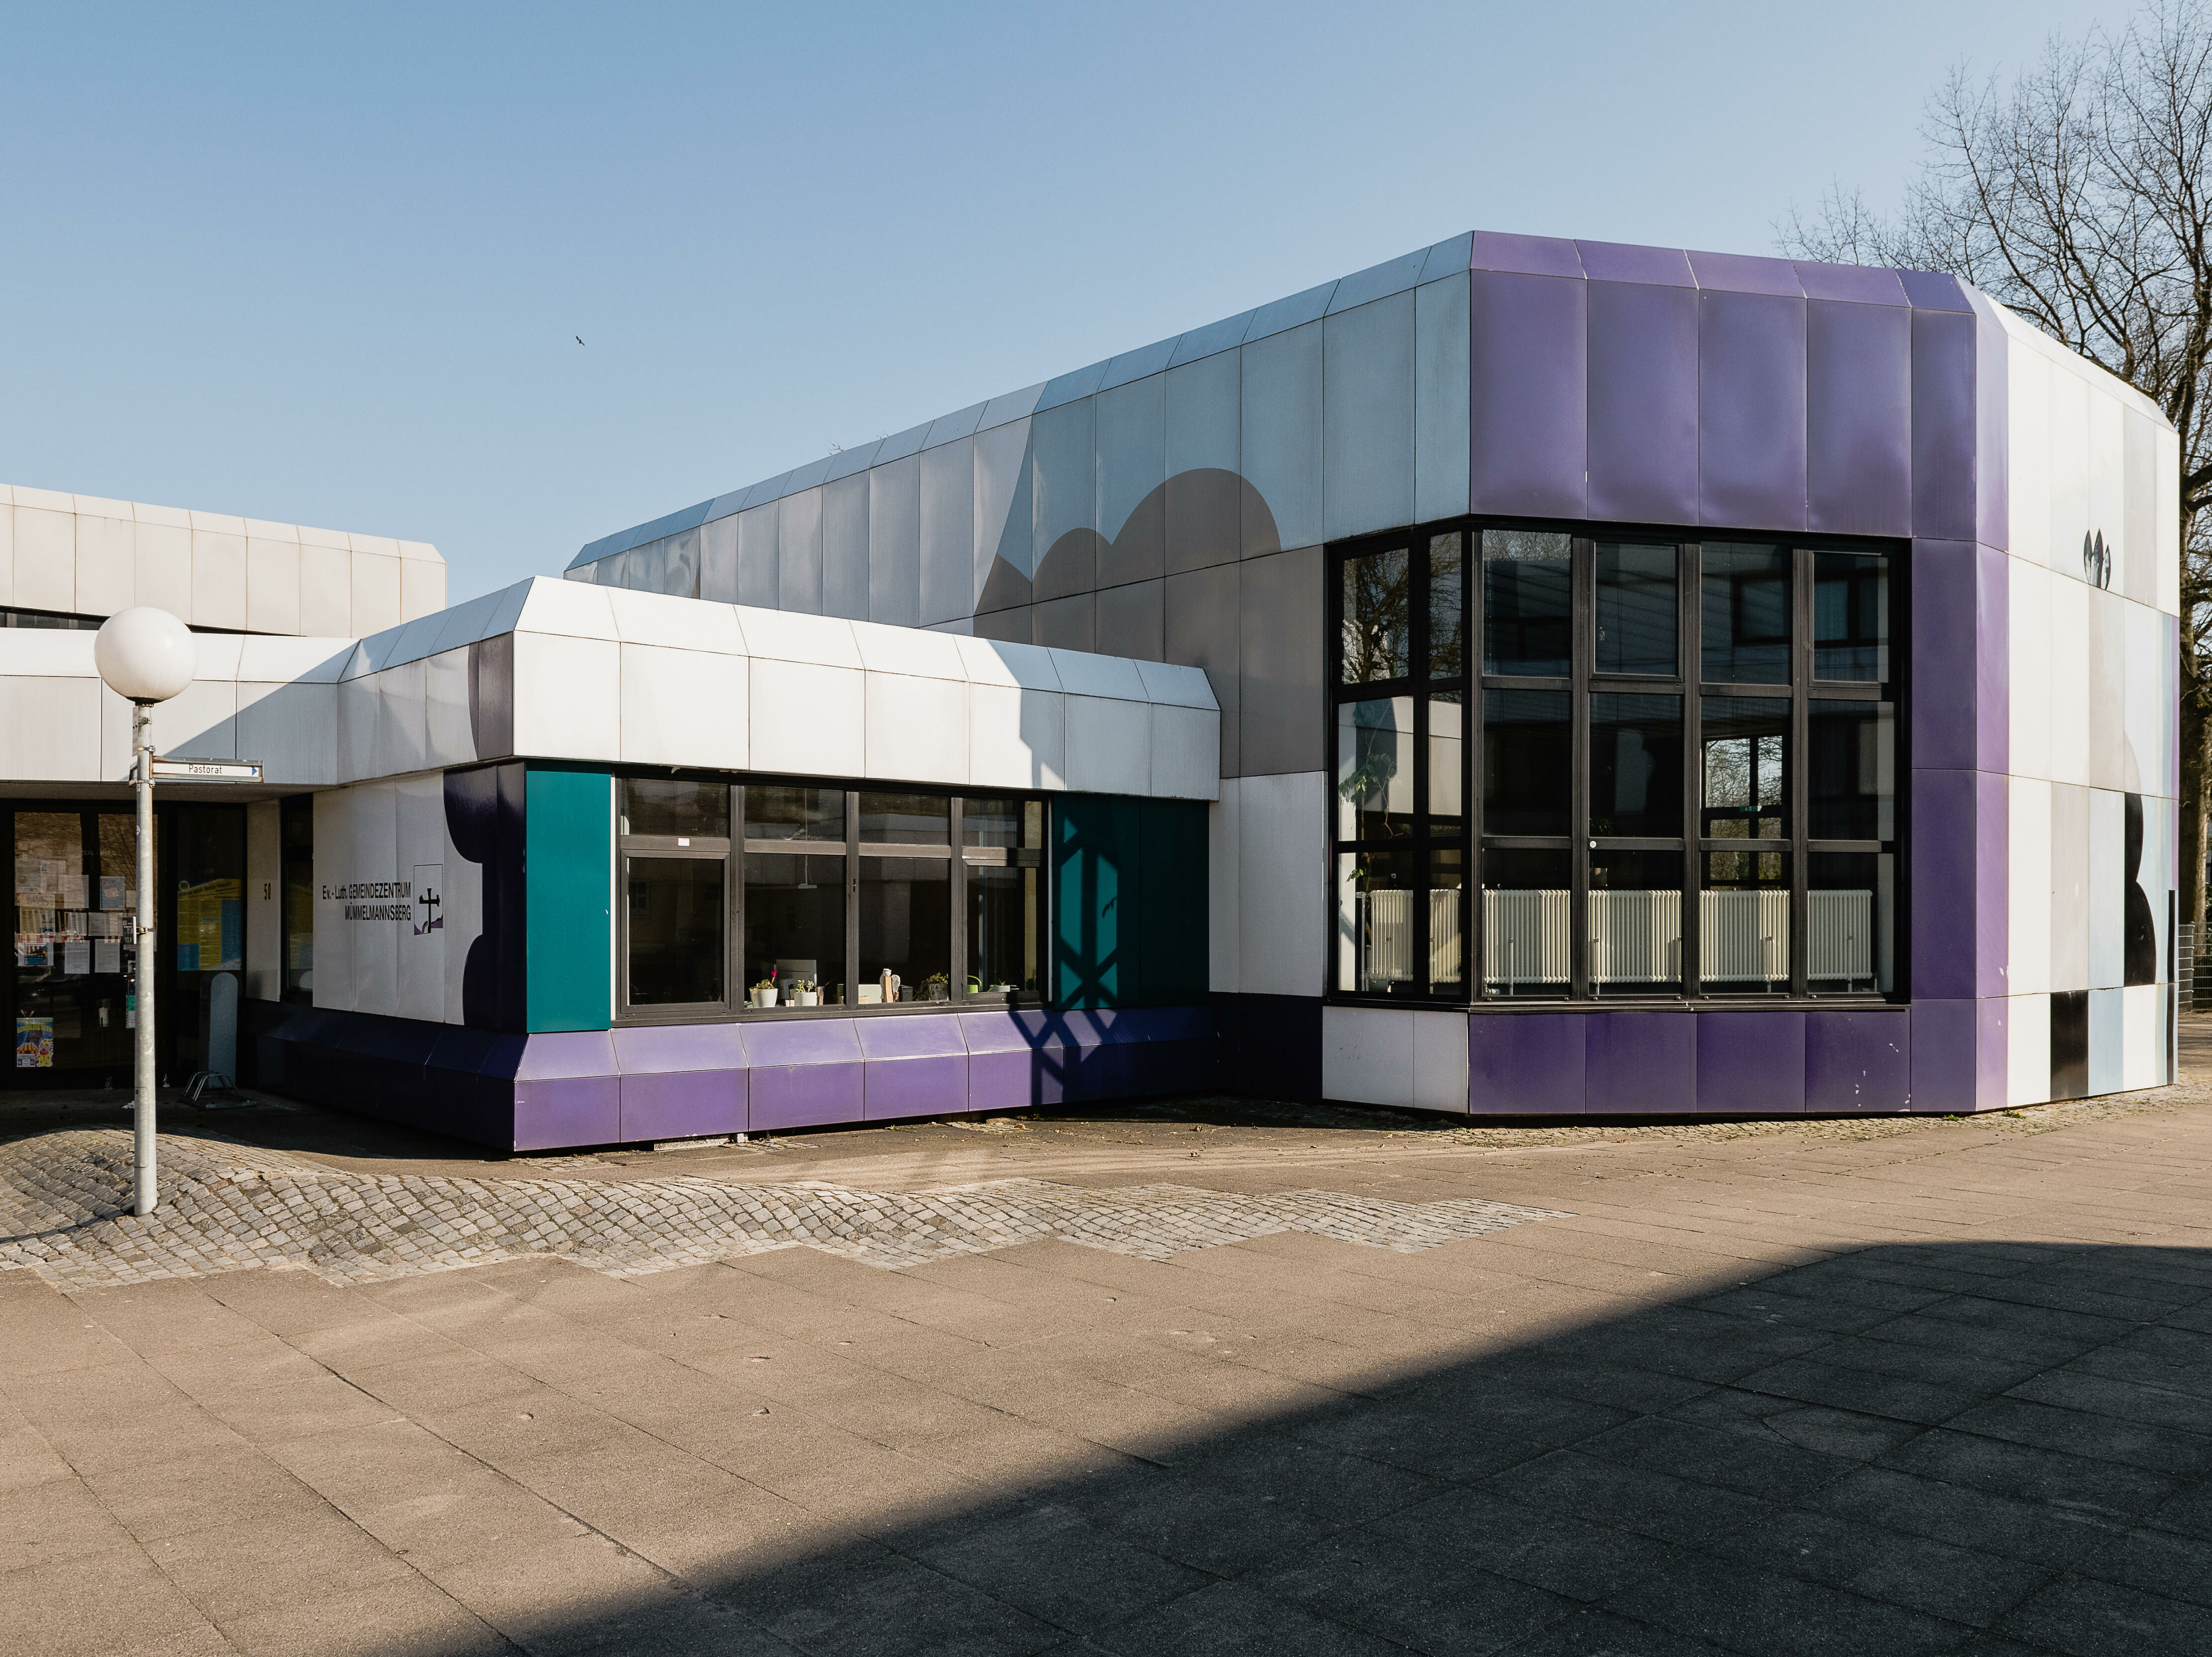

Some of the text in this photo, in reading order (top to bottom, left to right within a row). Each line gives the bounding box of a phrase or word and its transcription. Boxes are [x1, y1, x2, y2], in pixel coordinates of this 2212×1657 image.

[189, 764, 222, 773] Pastorat
[264, 883, 271, 900] 50
[349, 882, 411, 898] GEMEINDEZENTRUM
[345, 902, 411, 921] MÜMMELMANNSBERG
